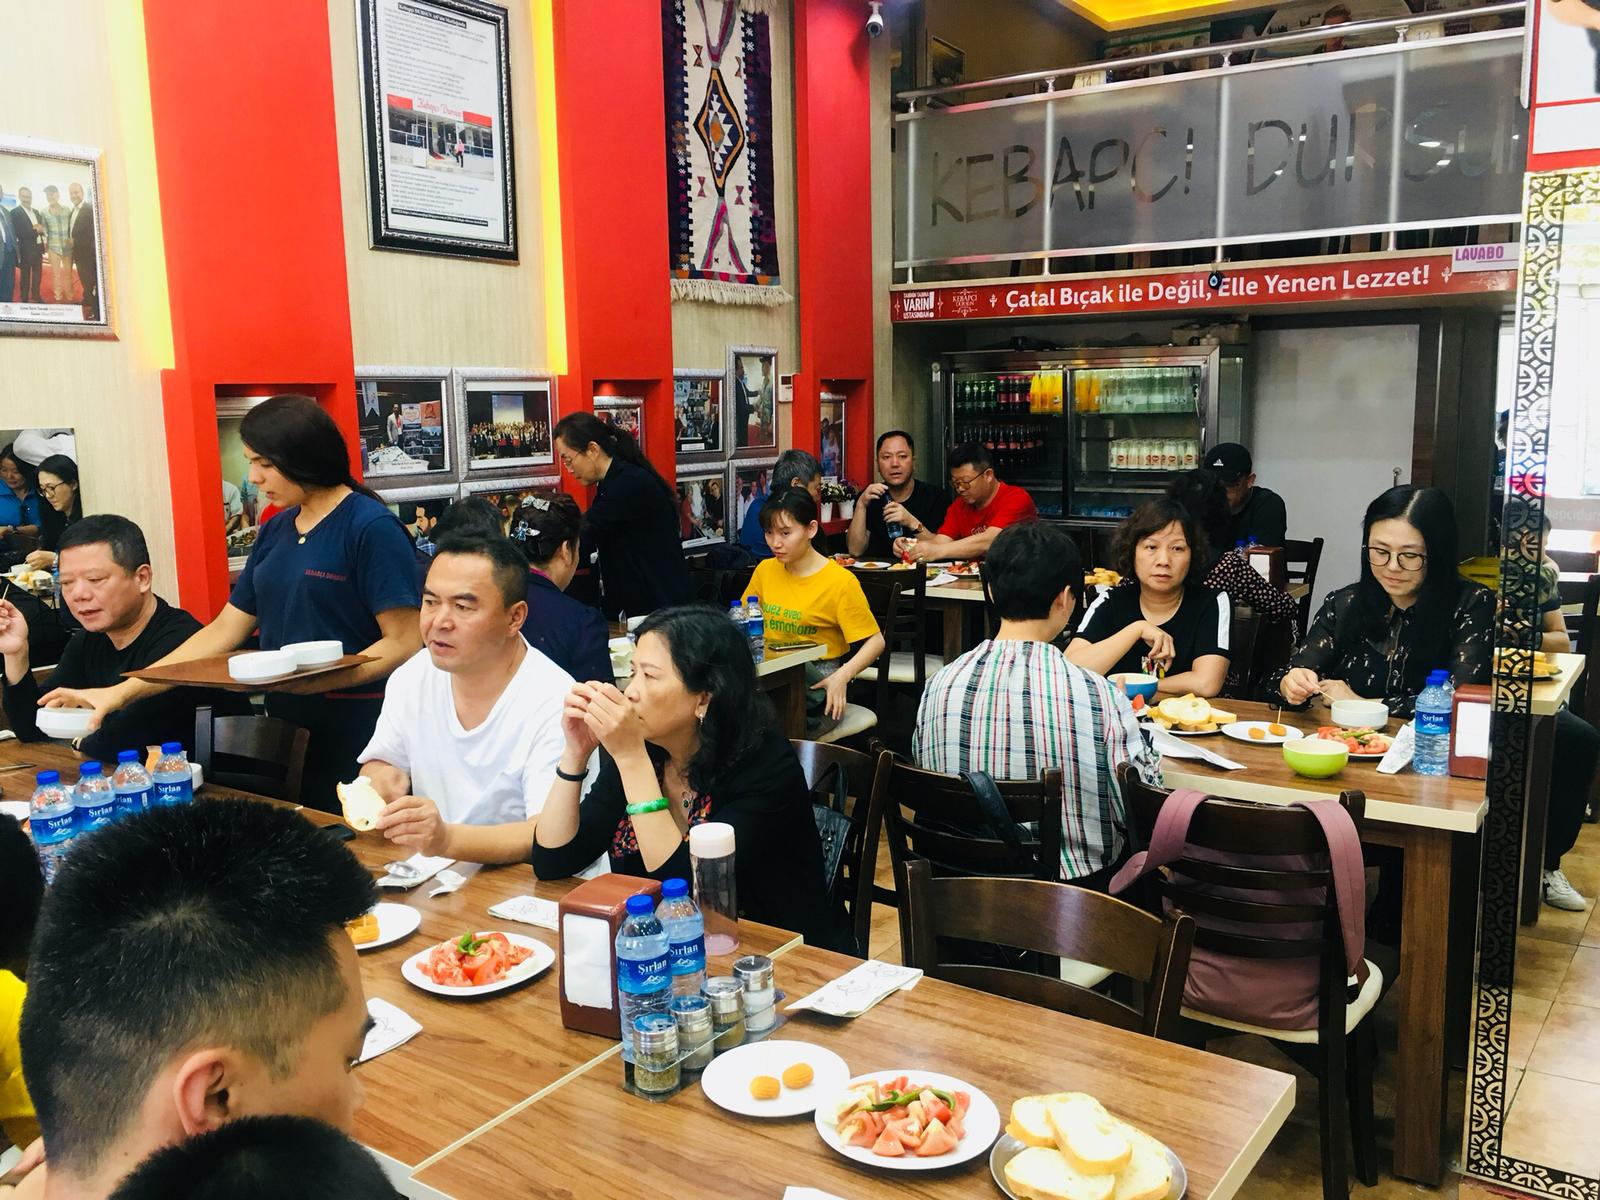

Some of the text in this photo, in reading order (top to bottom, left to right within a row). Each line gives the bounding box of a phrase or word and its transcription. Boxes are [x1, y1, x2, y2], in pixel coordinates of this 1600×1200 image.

[1455, 246, 1504, 261] LAVABO
[1006, 287, 1056, 313] Çatal
[1060, 285, 1114, 310] Bıçak
[1118, 283, 1143, 303] ile
[1218, 276, 1258, 297] Elle
[1264, 270, 1338, 295] Yenen
[1342, 264, 1430, 290] Lezzet!
